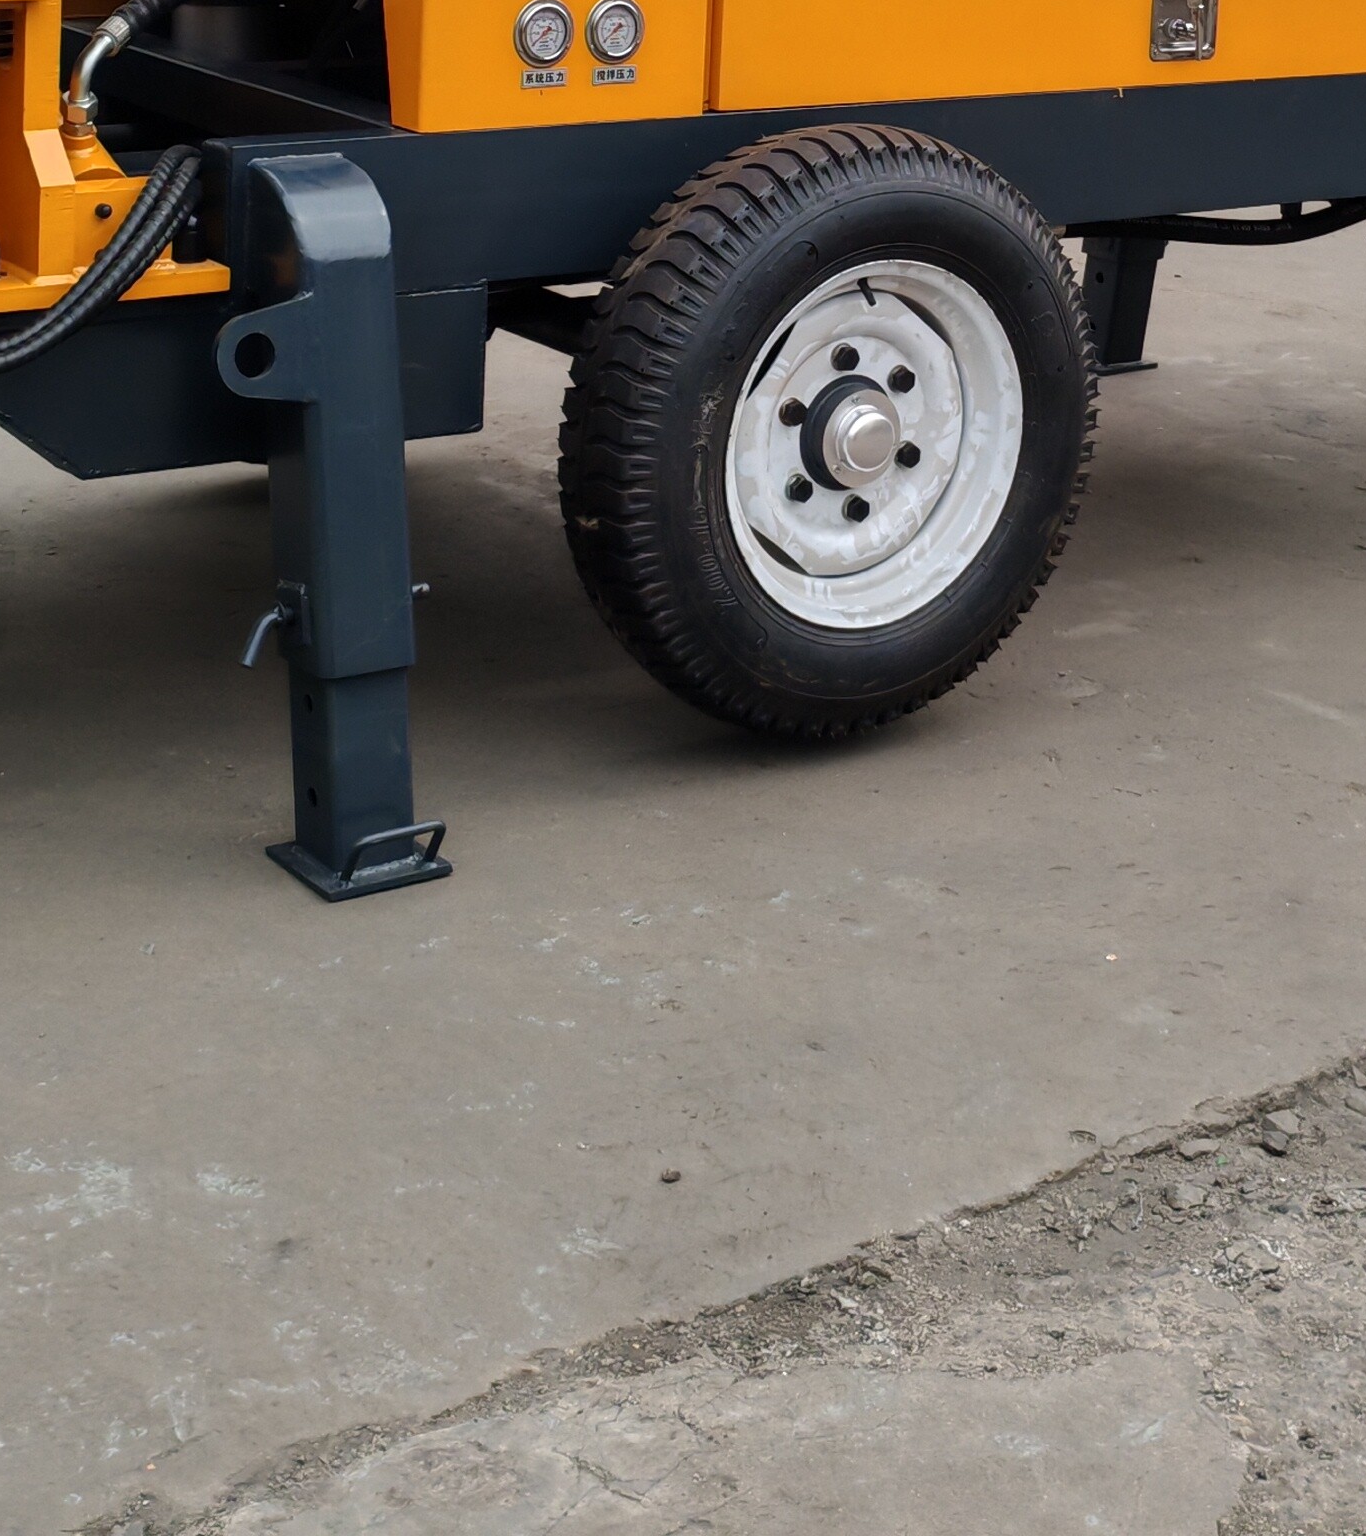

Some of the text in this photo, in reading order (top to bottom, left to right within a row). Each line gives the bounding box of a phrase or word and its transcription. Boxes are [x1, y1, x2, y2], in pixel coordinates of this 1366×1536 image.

[525, 72, 565, 84] 系统压力
[596, 69, 635, 81] 搅拌压力
